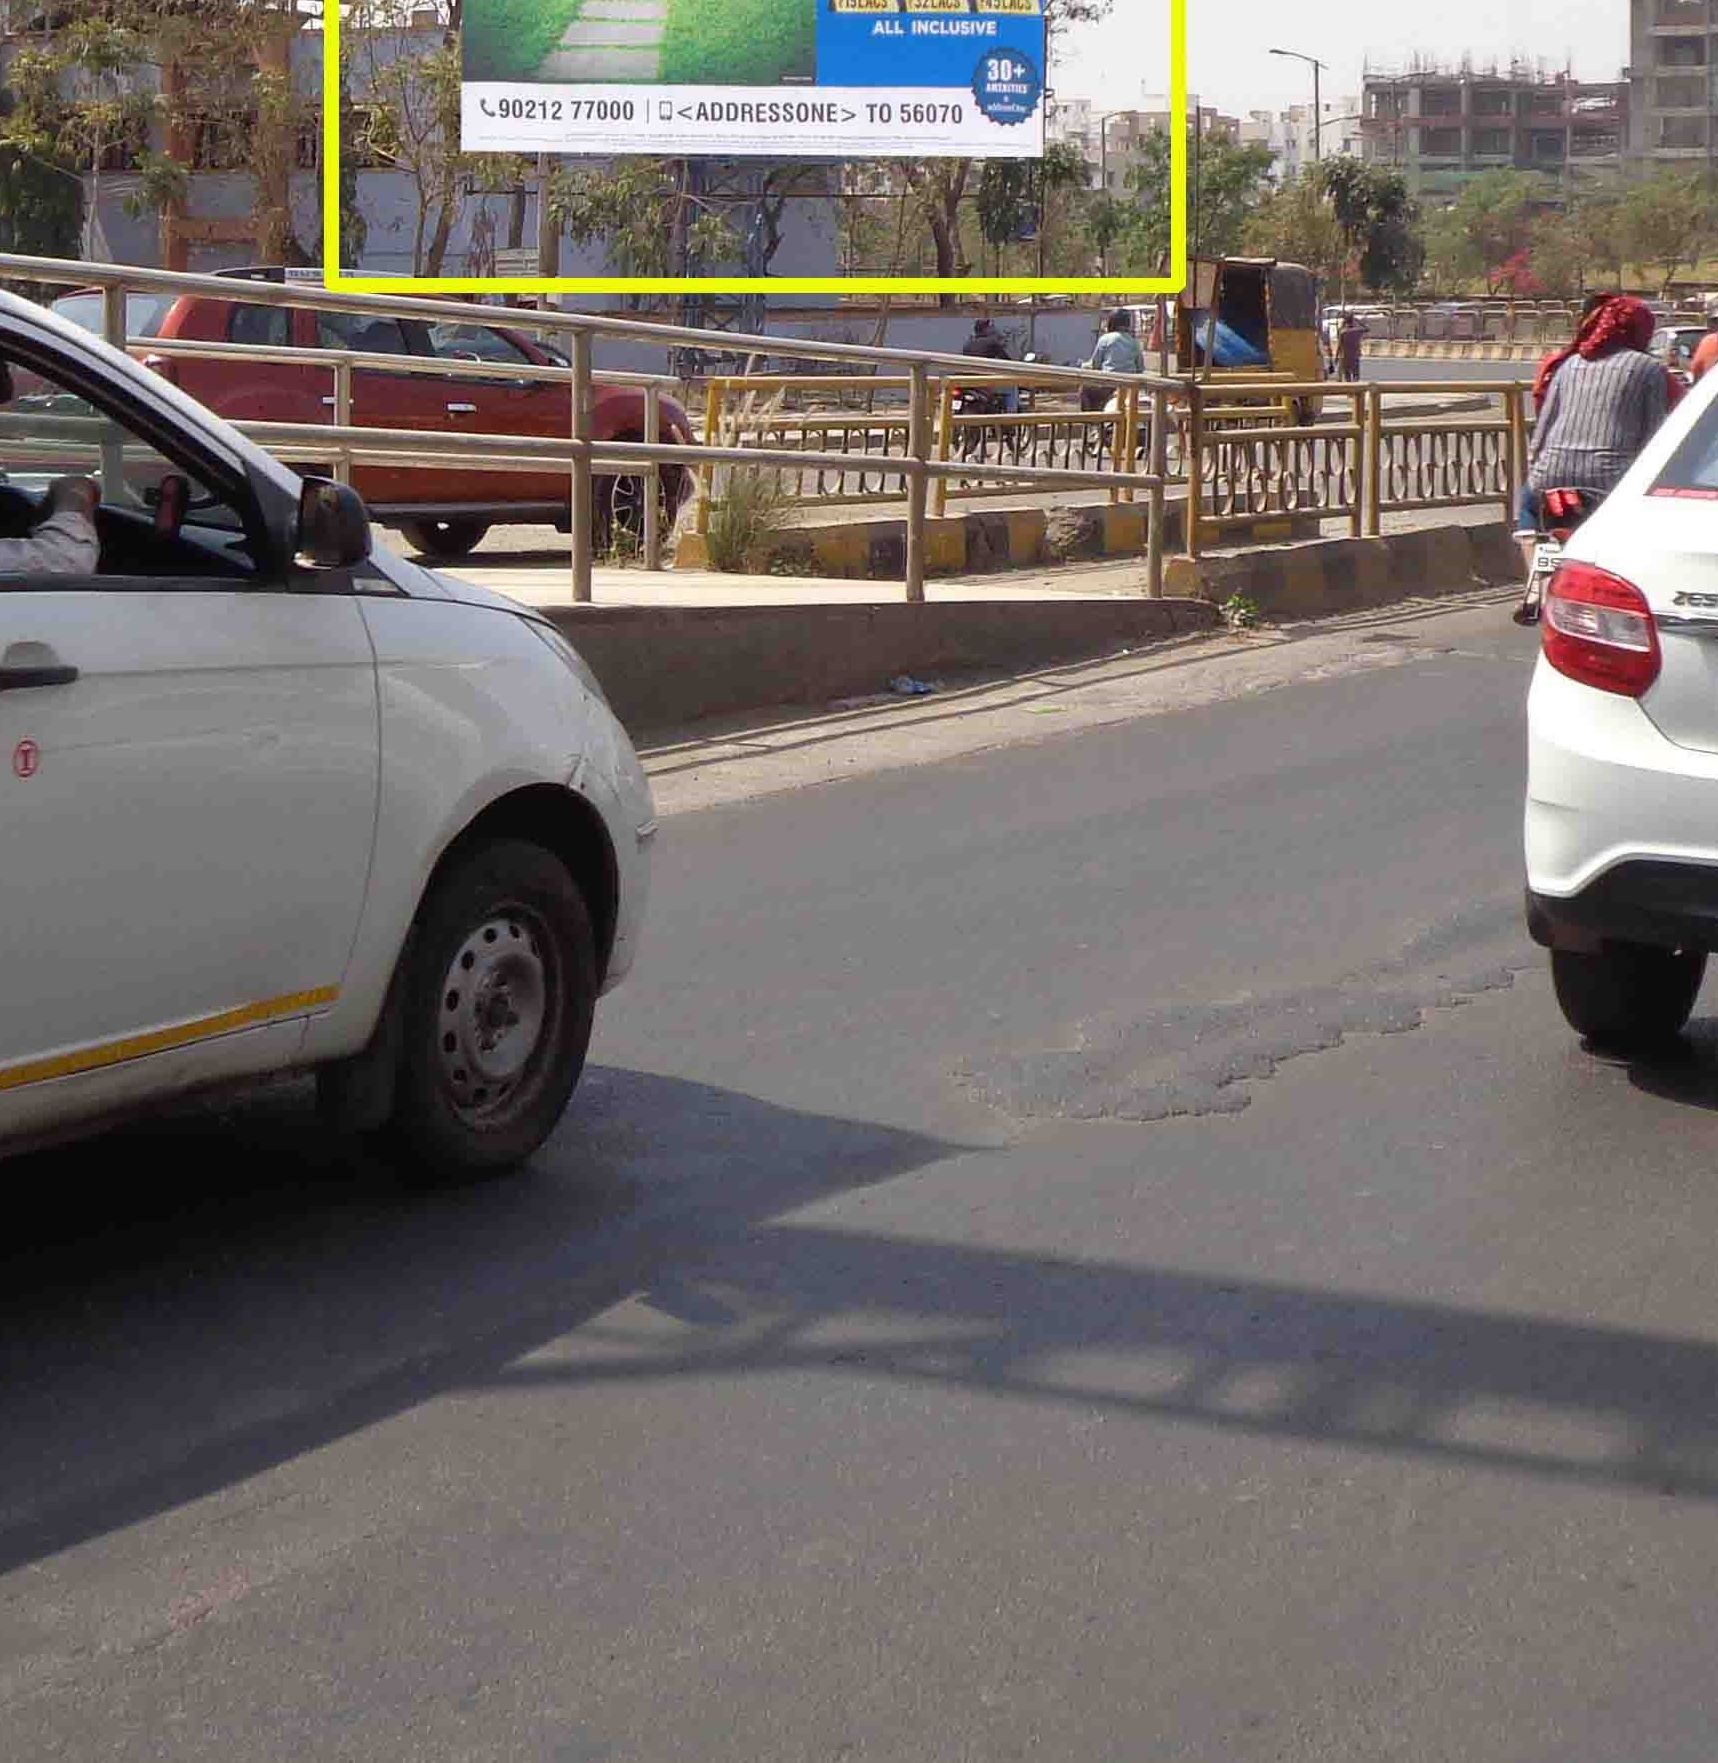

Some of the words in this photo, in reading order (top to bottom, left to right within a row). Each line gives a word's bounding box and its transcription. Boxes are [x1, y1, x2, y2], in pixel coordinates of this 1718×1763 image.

[872, 20, 904, 36] ALL
[912, 20, 997, 36] INCLUSIVE
[987, 59, 1026, 81] 30+
[499, 98, 563, 119] 90212
[571, 99, 635, 120] 77000
[866, 103, 892, 123] TO
[900, 104, 963, 124] 56070
